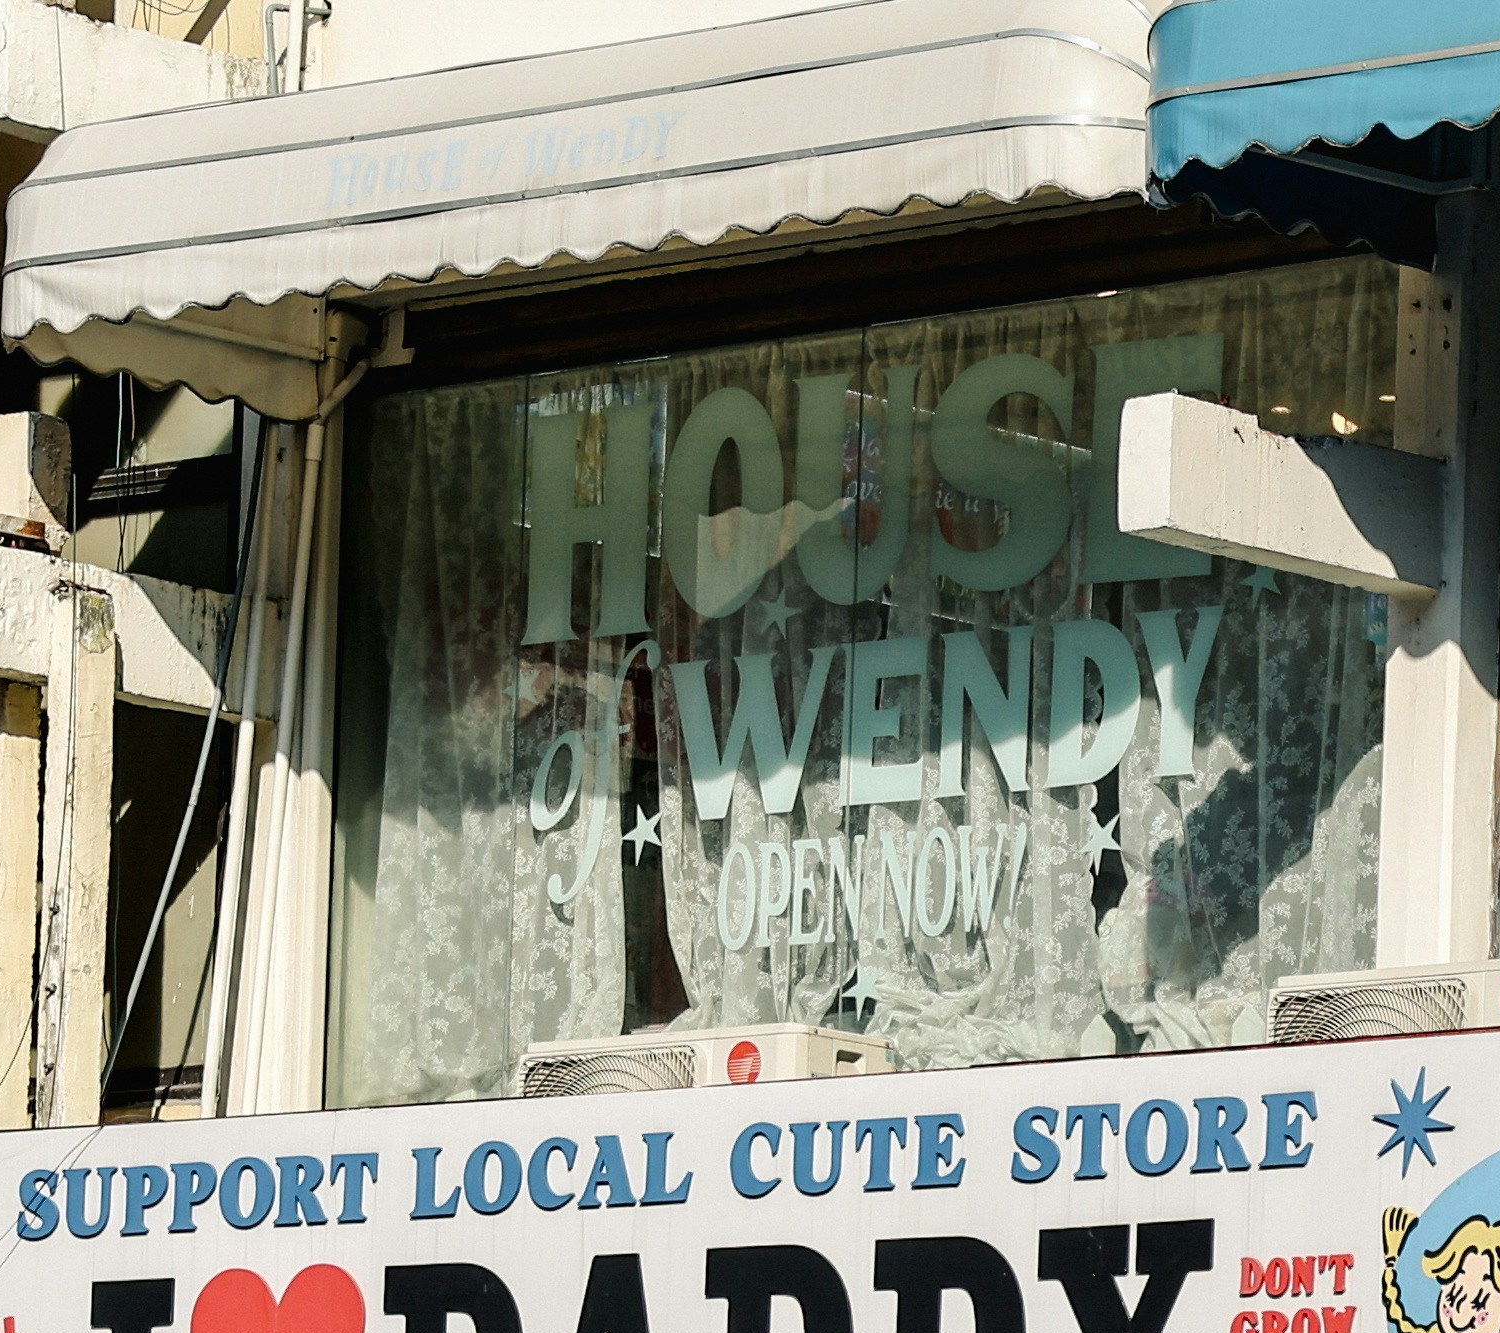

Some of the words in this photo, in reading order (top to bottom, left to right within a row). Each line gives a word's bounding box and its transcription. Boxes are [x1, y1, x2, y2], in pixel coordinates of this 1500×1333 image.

[522, 332, 1224, 646] HOUSE
[528, 640, 662, 905] of
[668, 603, 1224, 820] WENDY
[717, 830, 866, 952] OPEN
[872, 820, 1028, 938] NOW!
[16, 1152, 380, 1241] SUPPORT
[409, 1130, 694, 1221] LOCAL
[729, 1112, 967, 1199] CUTE
[1011, 1089, 1319, 1185] STORE
[1239, 1252, 1354, 1299] DON'T
